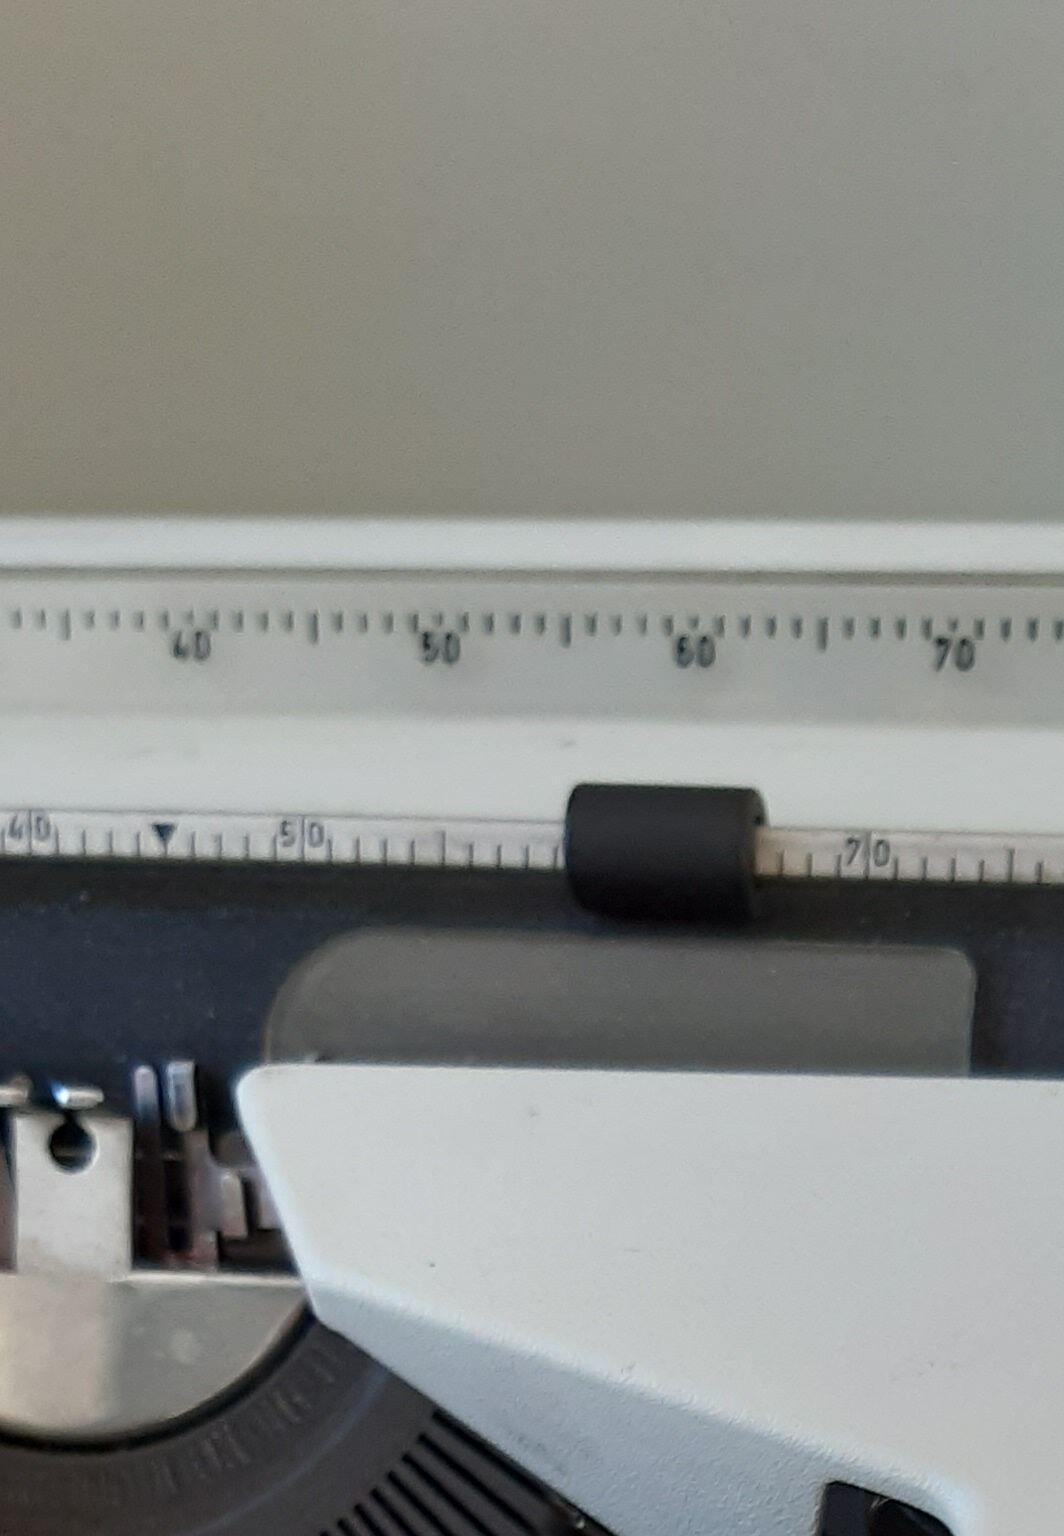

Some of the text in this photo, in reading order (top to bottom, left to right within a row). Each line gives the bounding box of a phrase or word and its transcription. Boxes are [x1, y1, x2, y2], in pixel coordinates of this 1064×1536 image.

[171, 630, 211, 663] 40
[419, 630, 462, 666] 50
[673, 633, 717, 669] 60
[933, 636, 975, 673] 70
